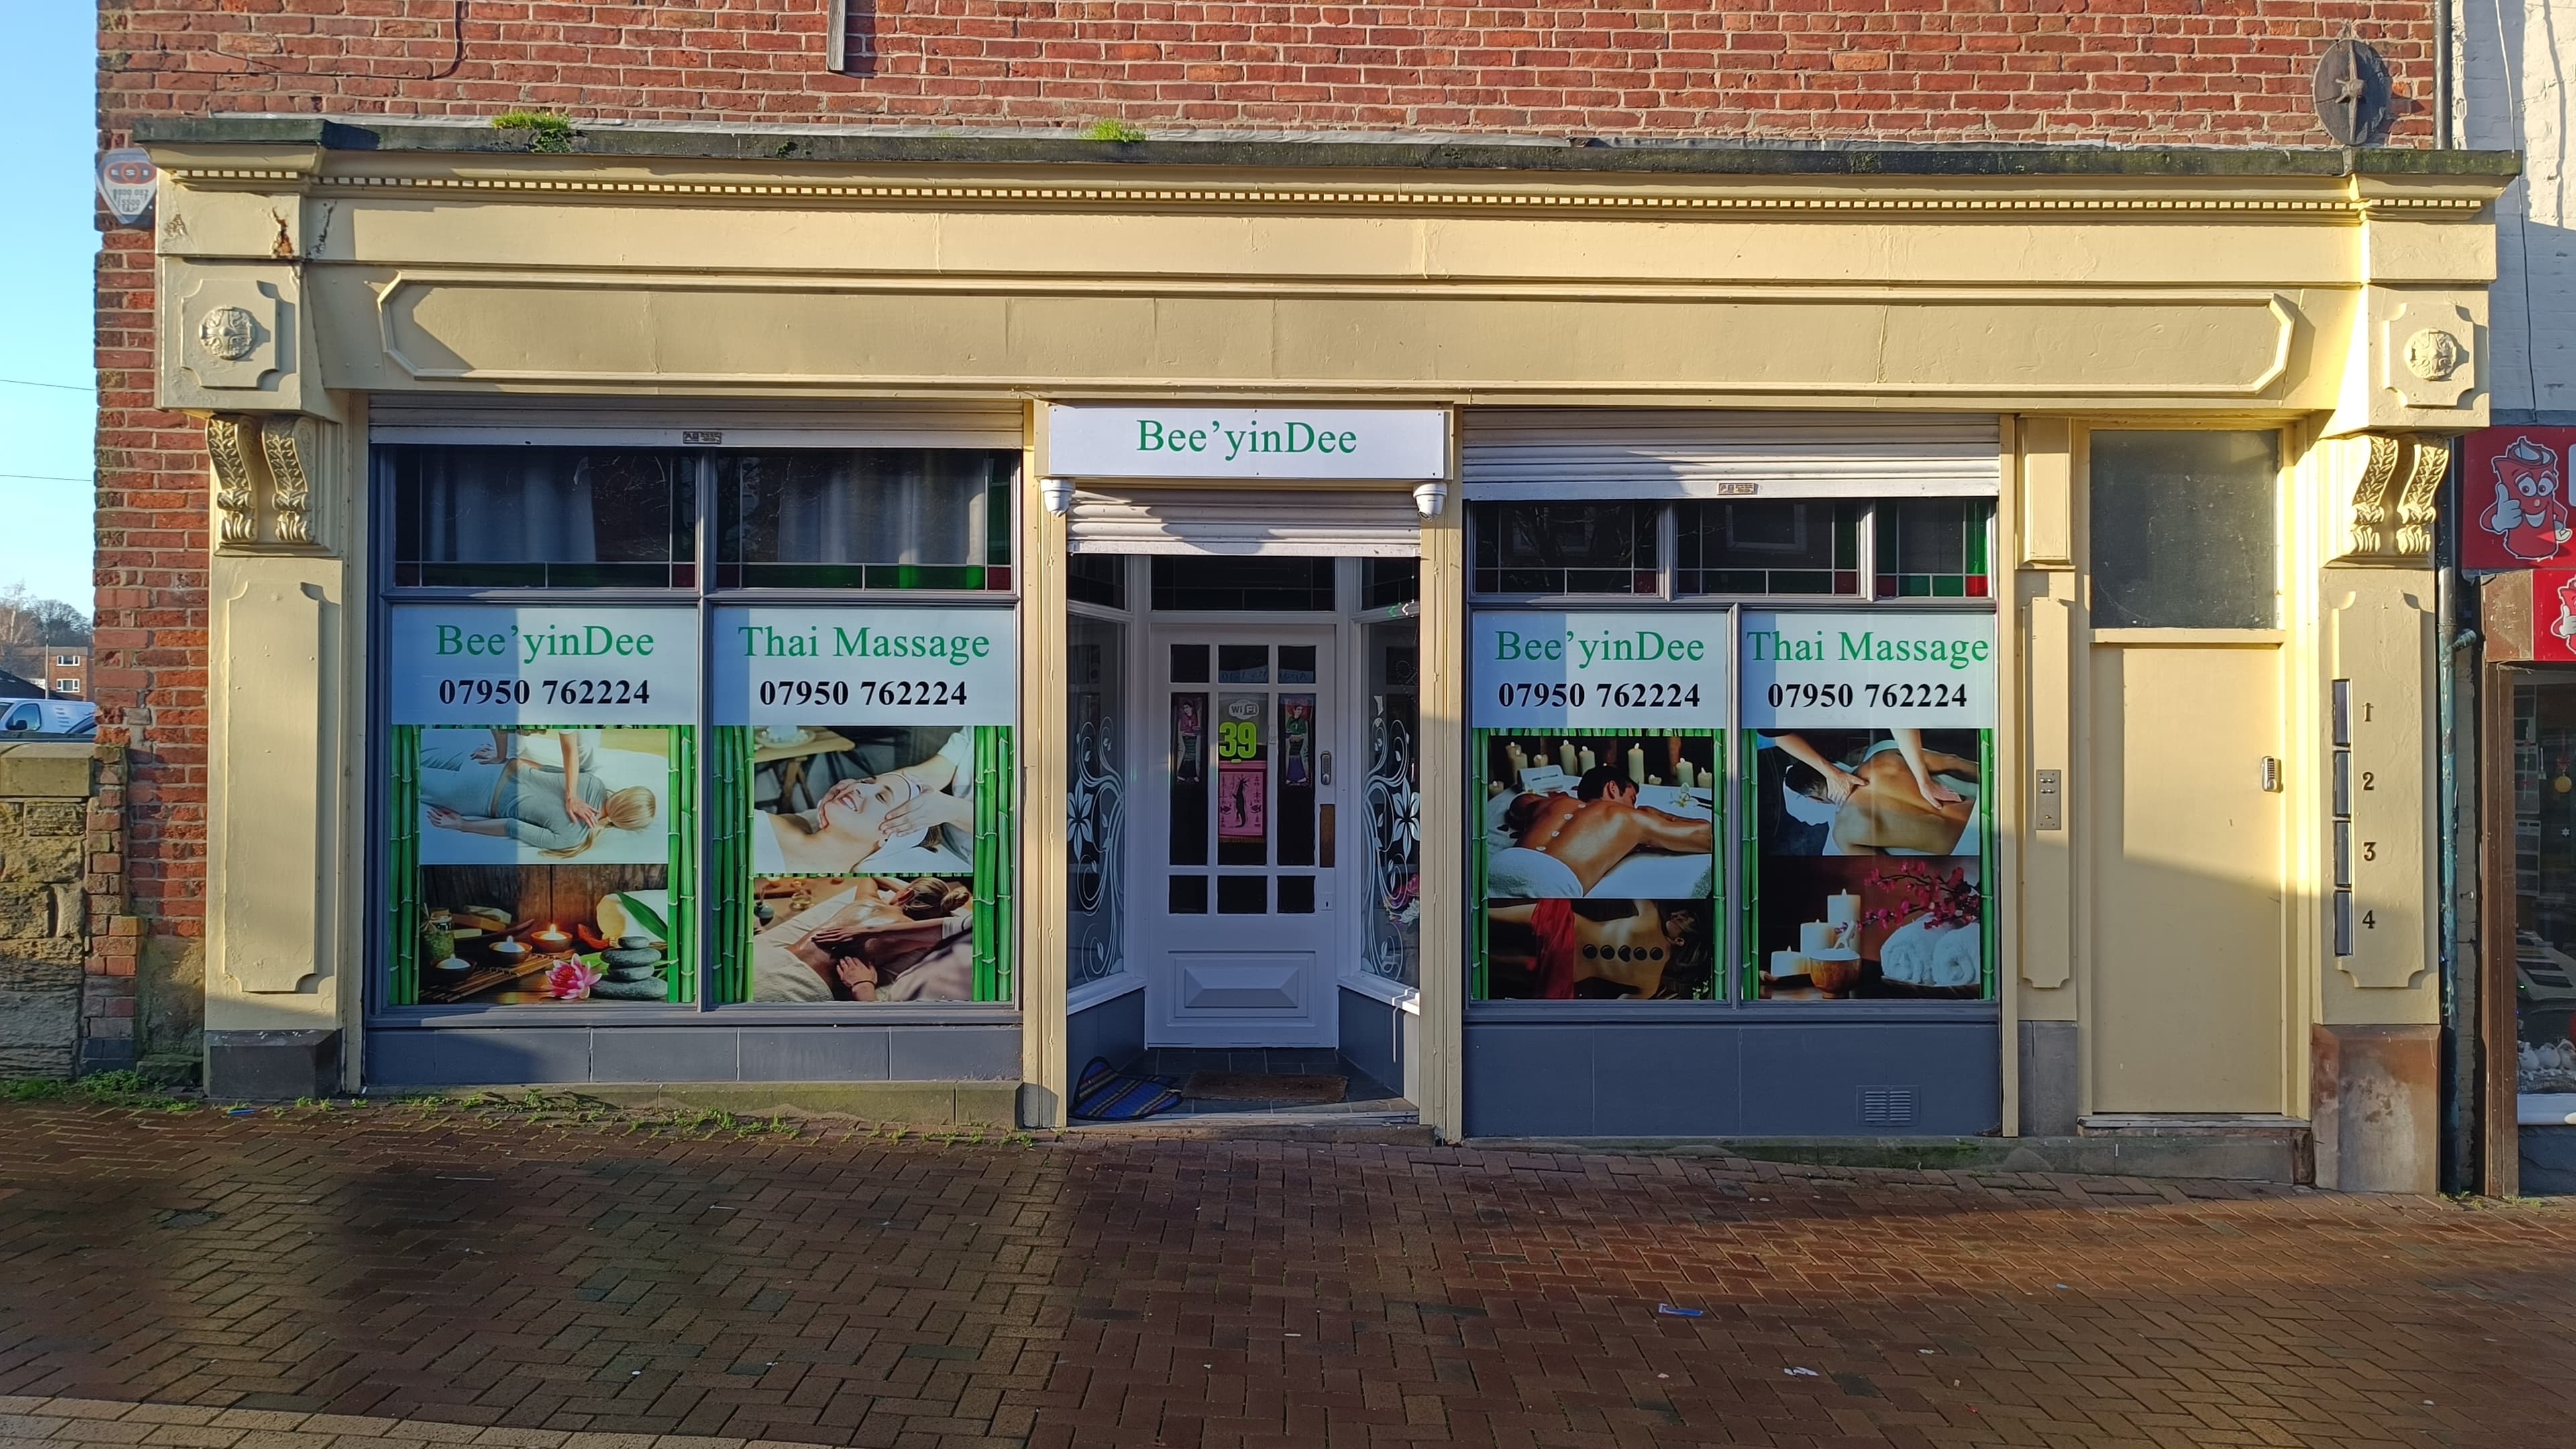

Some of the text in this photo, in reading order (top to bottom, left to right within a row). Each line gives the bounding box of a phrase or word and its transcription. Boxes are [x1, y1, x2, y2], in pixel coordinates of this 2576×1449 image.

[1136, 419, 1357, 462] Bee'yinDee
[435, 624, 655, 666] Bee'yinDee
[738, 625, 990, 666] Thai Massage
[1495, 630, 1705, 669] Bee'yinDee
[1746, 631, 1990, 671] Thai Massage
[439, 680, 650, 705] 07950 762224
[759, 680, 967, 706] 07950 762224
[1498, 682, 1701, 708] 07950 762224
[1767, 683, 1968, 708] 07950 762224
[2361, 702, 2373, 722] 1
[1219, 722, 1256, 758] 39
[2361, 771, 2375, 791] 2
[2362, 841, 2377, 861] 3
[2361, 910, 2376, 929] 4
